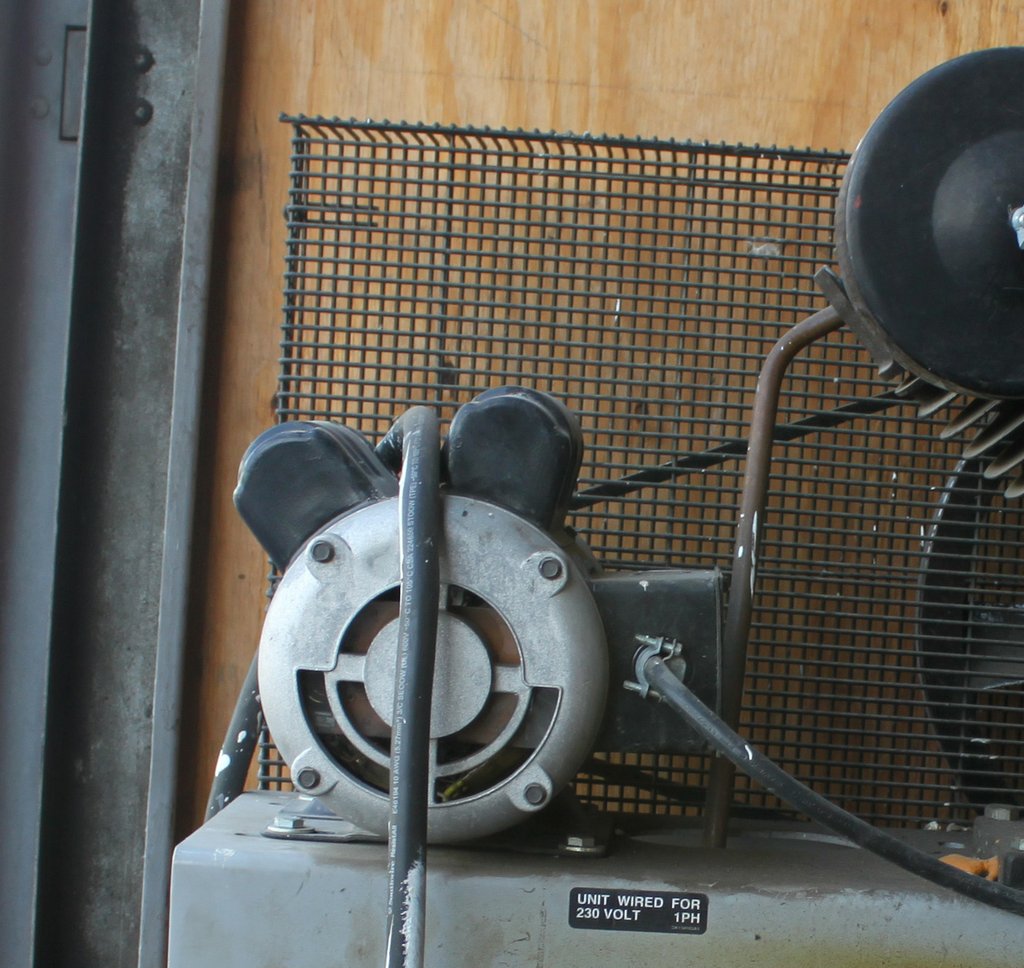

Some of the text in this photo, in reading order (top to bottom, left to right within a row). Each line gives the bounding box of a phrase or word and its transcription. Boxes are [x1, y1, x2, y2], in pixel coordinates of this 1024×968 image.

[577, 893, 701, 910] UNIT WIRED FOR
[576, 907, 701, 924] 230 VOLT 1PH
